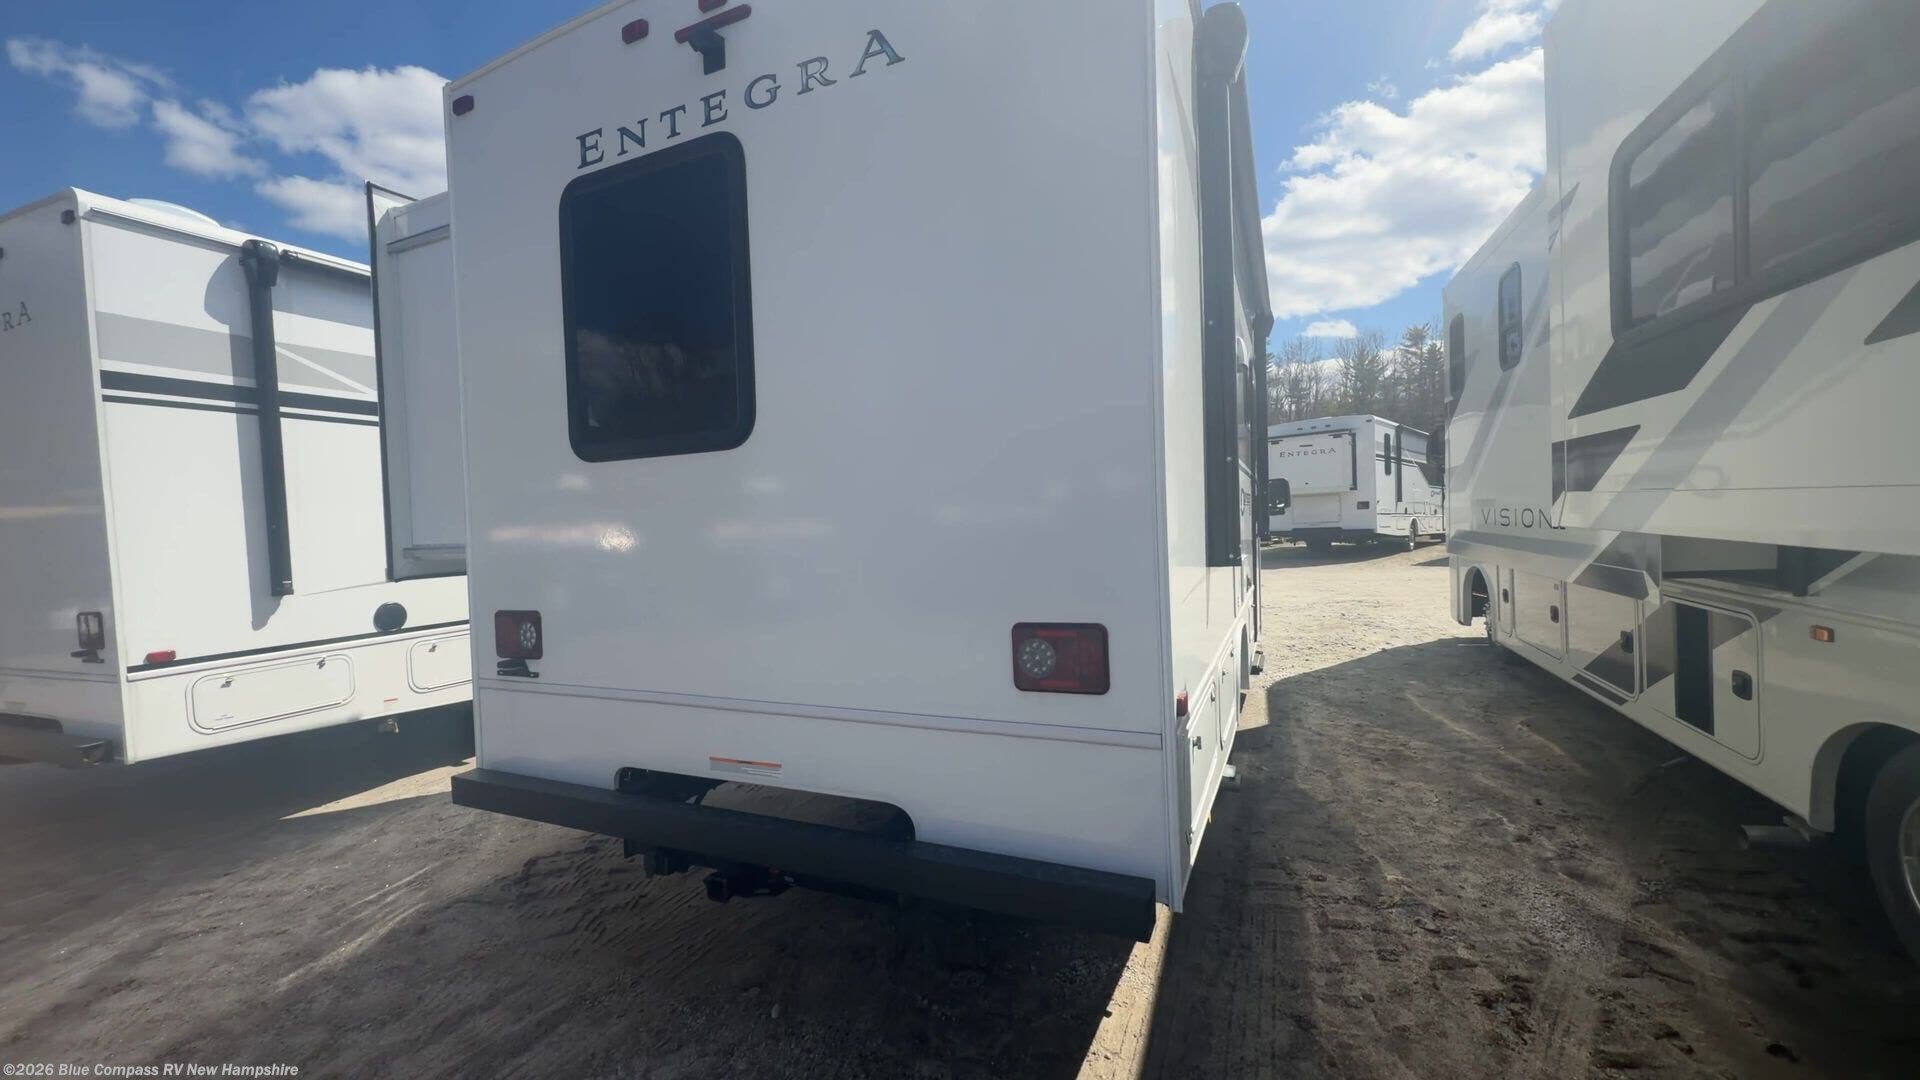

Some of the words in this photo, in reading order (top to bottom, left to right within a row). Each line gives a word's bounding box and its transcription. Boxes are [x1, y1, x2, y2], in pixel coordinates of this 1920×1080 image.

[576, 29, 906, 170] ENTEGRA
[1279, 447, 1337, 458] ENTEGRA
[1481, 507, 1553, 529] VISION
